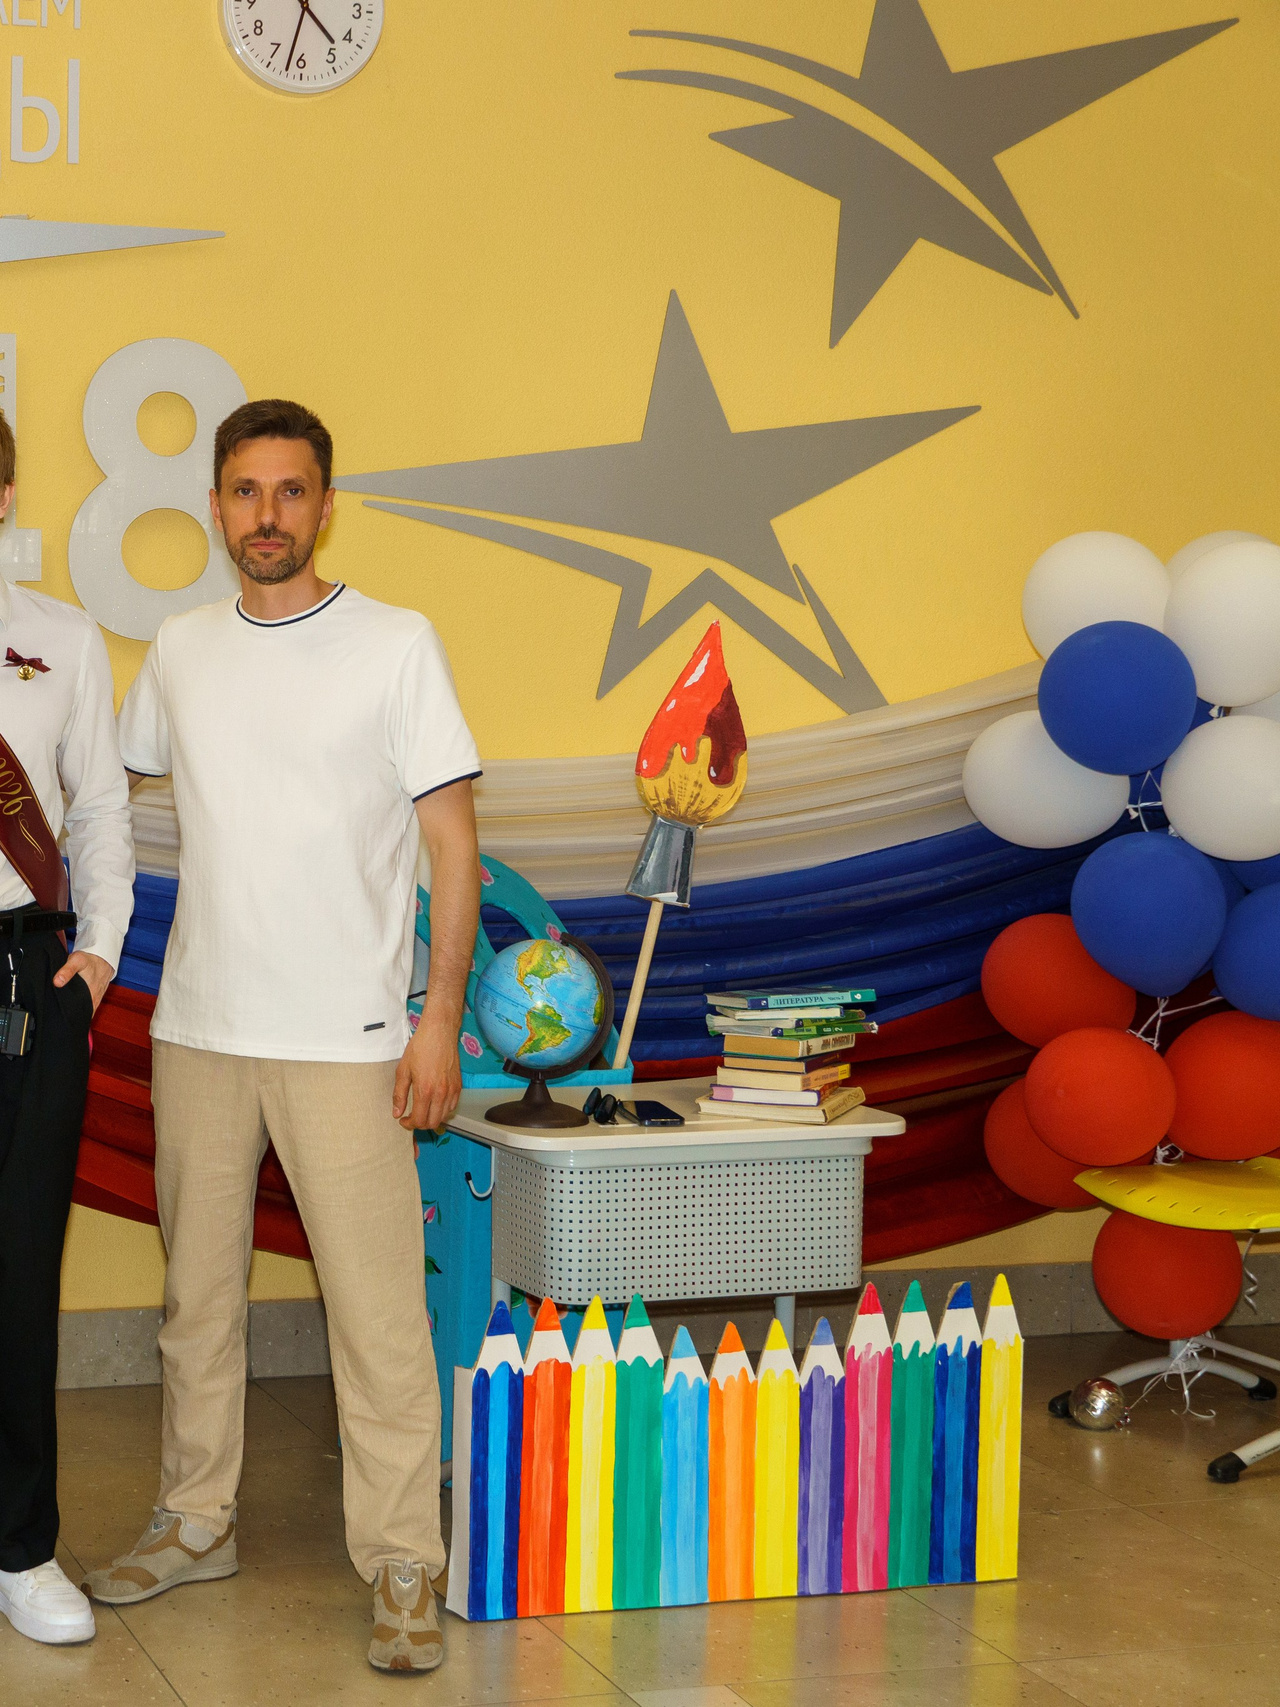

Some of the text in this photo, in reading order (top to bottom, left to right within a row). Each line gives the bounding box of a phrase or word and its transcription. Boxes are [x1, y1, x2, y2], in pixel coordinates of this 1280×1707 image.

[352, 3, 362, 20] 3
[253, 19, 264, 36] 8
[342, 28, 353, 44] 4
[270, 42, 282, 59] 7
[325, 47, 337, 64] 5
[296, 53, 306, 69] 6
[773, 996, 824, 1006] ЛИТЕРАТУРА
